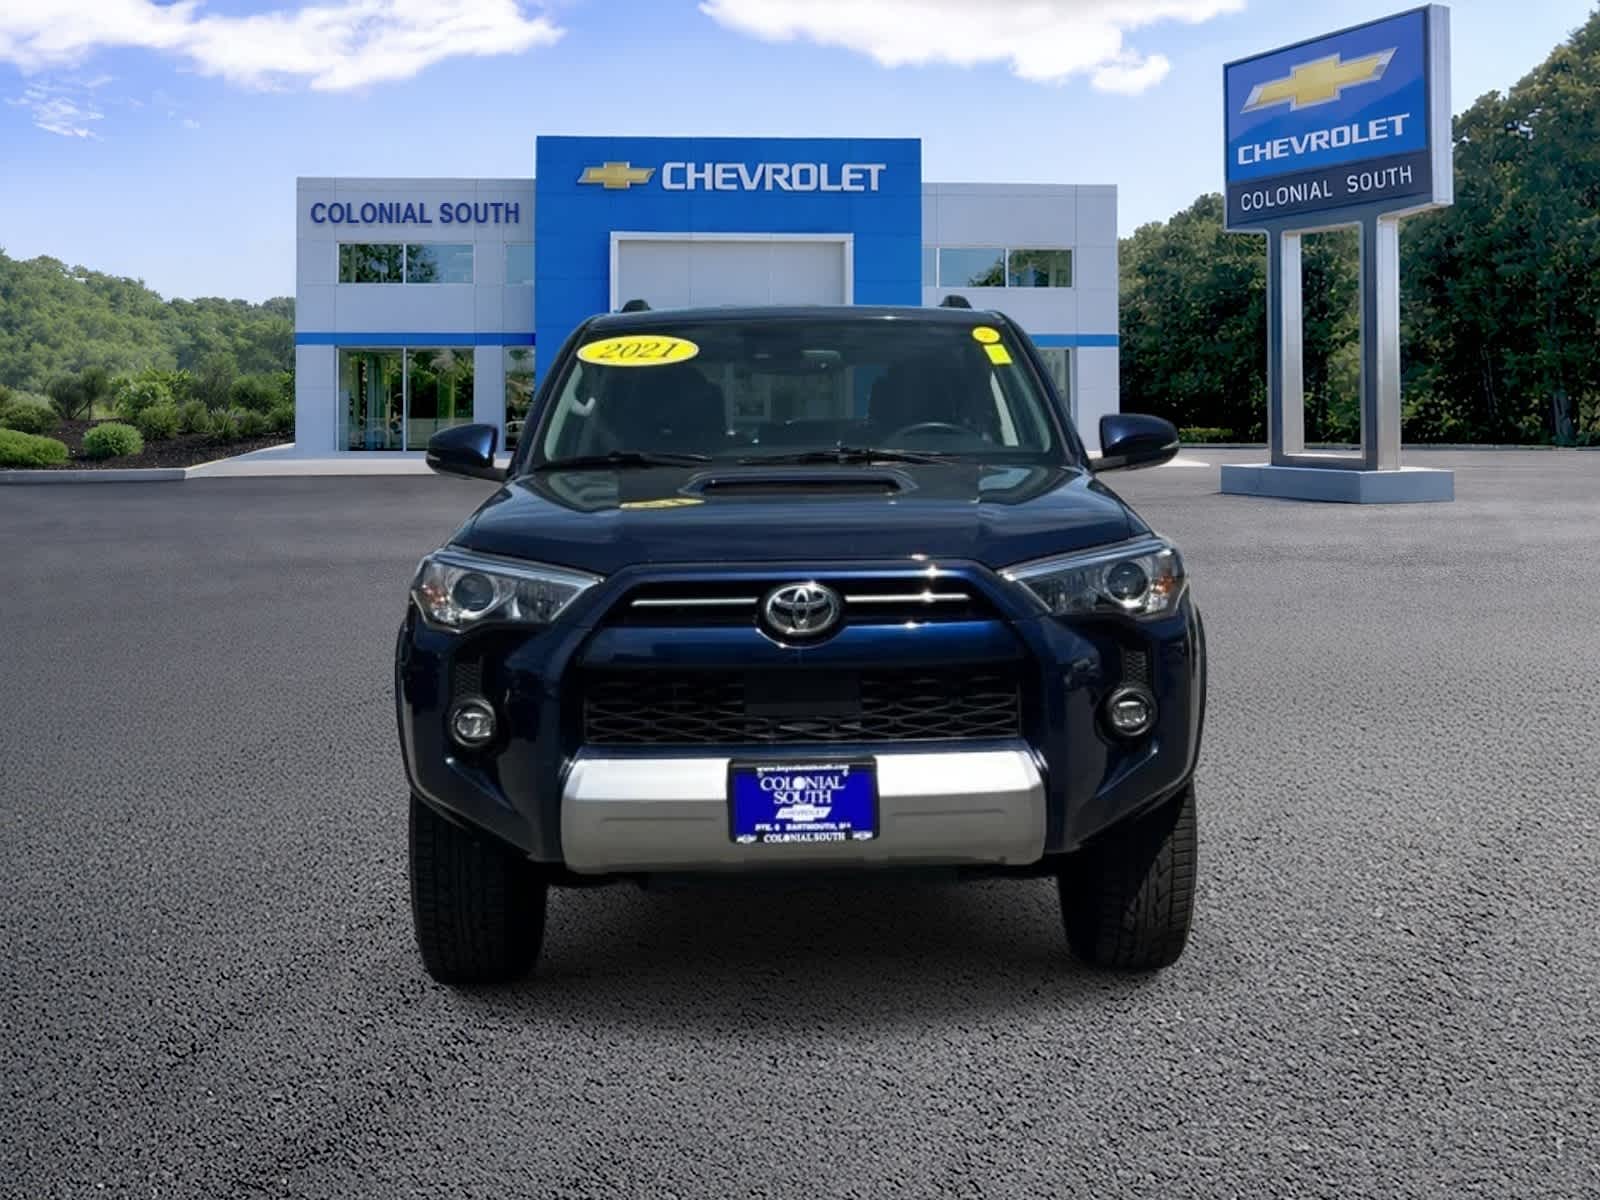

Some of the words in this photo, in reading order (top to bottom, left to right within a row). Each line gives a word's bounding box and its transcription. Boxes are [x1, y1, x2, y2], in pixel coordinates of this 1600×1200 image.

[1237, 113, 1410, 166] CHEVROLET
[661, 161, 887, 192] CHEVROLET
[1240, 179, 1333, 212] COLONIAL
[1346, 165, 1413, 193] SOUTH
[310, 202, 433, 224] COLONIAL
[439, 202, 520, 224] SOUTH
[597, 342, 679, 359] 2021
[760, 776, 846, 791] COLONIAL
[773, 790, 832, 804] SOUTH
[763, 833, 812, 843] COLONIAL
[814, 832, 846, 841] SOUTH
